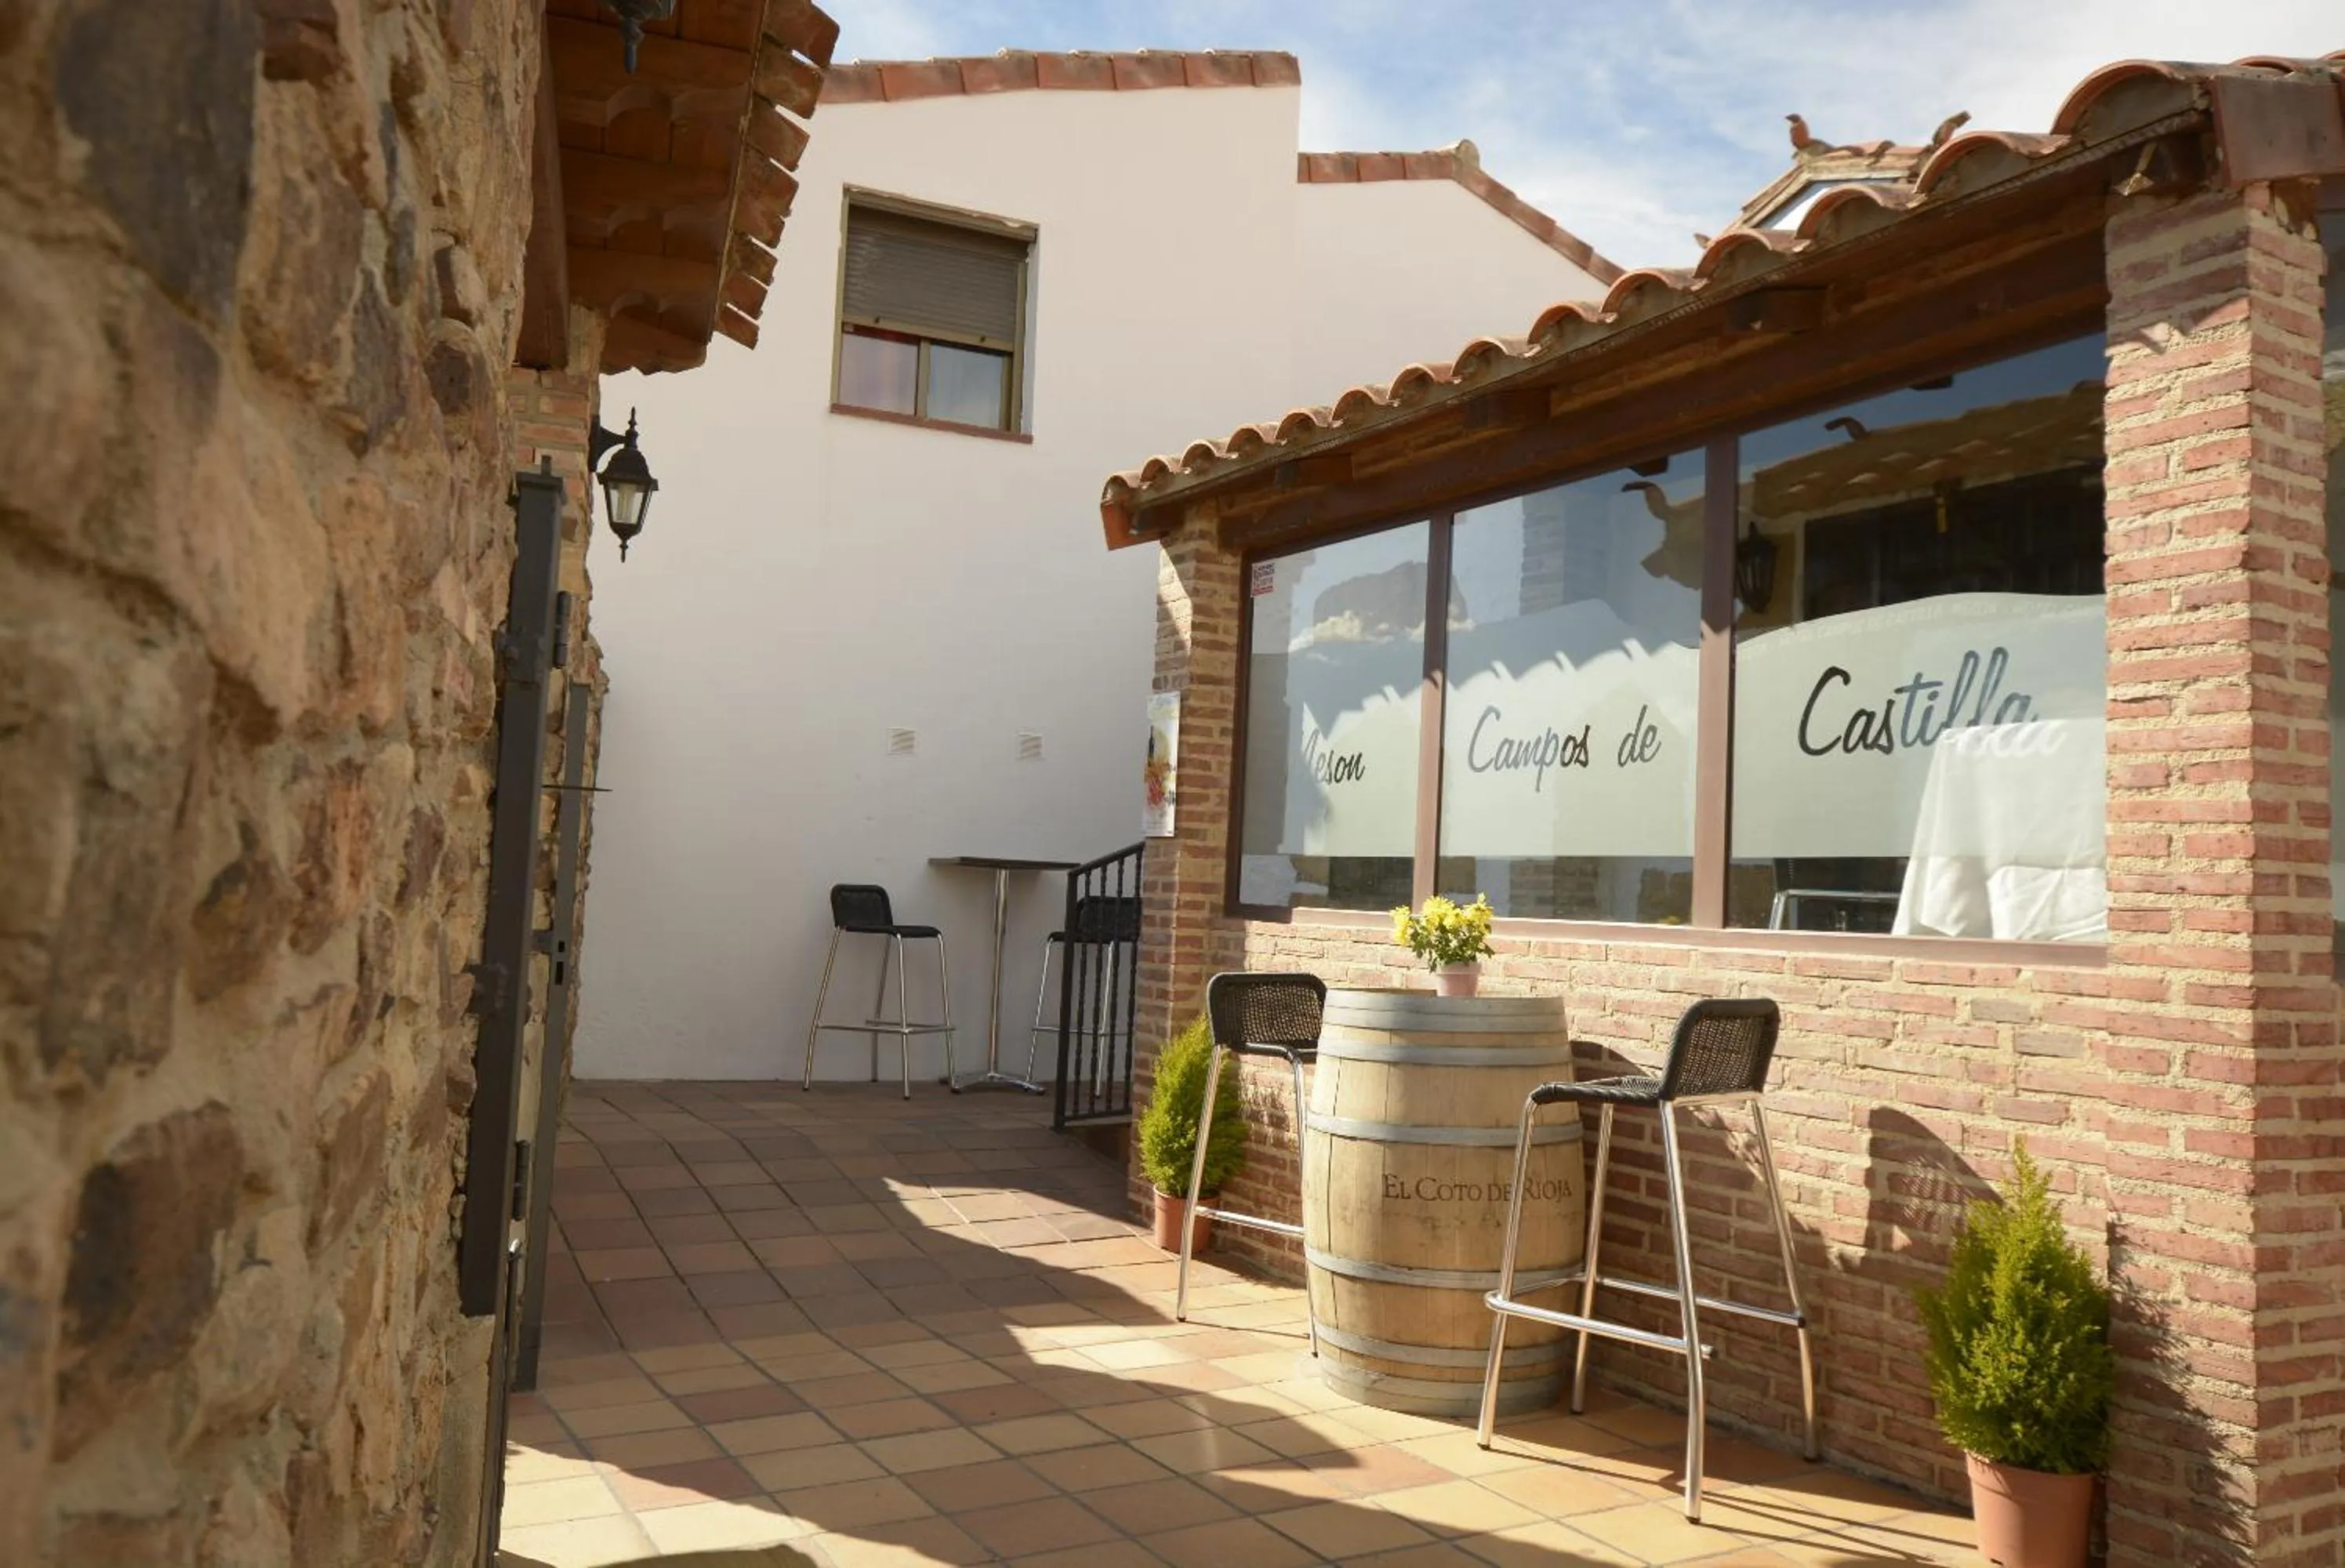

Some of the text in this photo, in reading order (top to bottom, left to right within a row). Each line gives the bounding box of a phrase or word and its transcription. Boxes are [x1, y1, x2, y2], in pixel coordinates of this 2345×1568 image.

[1468, 704, 1591, 793] Campos
[1617, 703, 1662, 768] de
[1383, 1173, 1411, 1200] EL
[1415, 1176, 1483, 1202] COTO
[1486, 1184, 1512, 1202] DE
